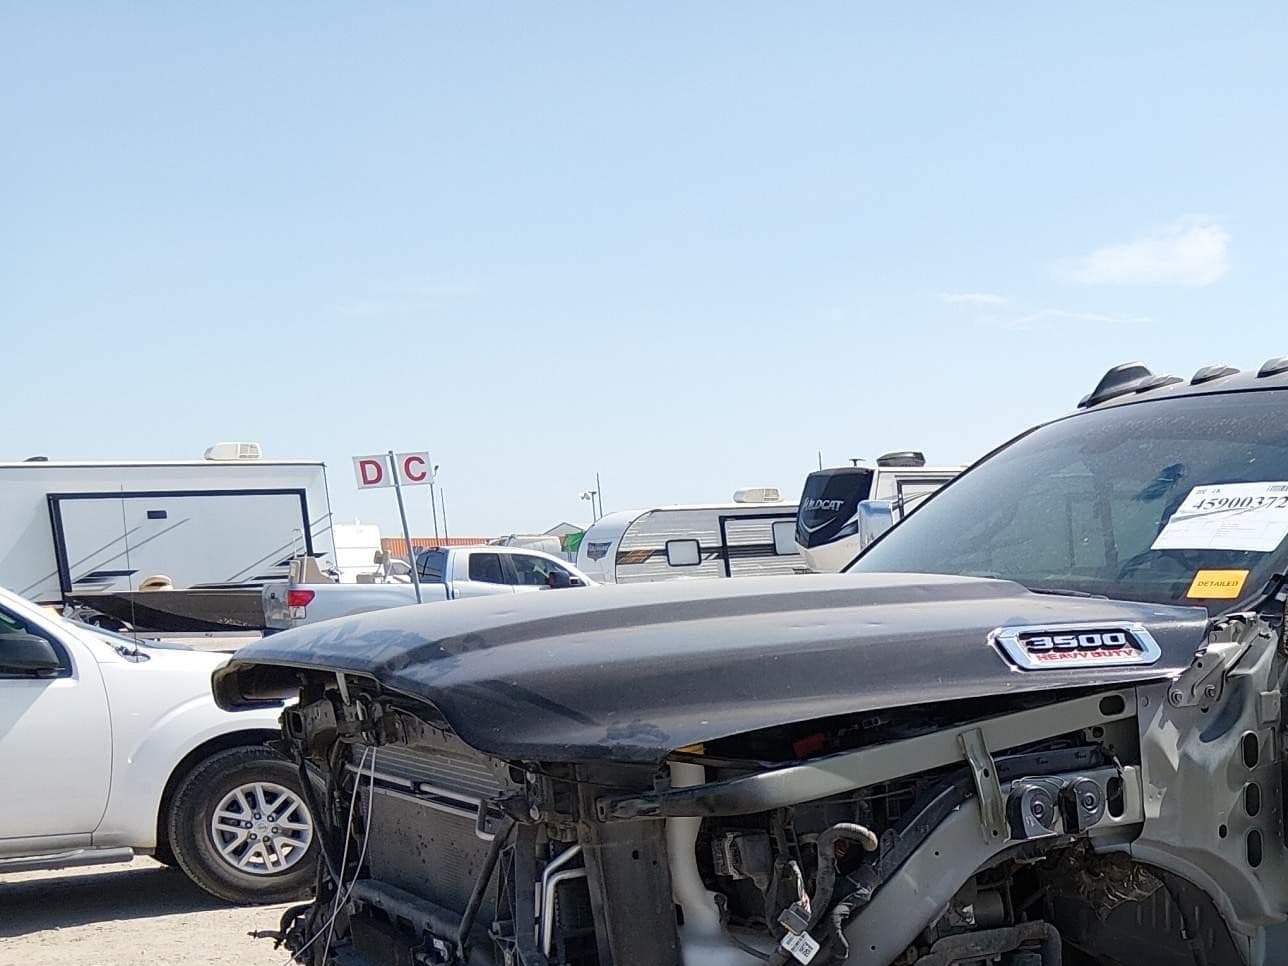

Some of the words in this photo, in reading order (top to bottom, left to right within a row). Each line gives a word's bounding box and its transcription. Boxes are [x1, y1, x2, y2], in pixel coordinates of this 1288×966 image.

[359, 460, 383, 485] D
[404, 456, 427, 482] C
[1027, 632, 1127, 650] 3500
[1036, 652, 1088, 662] HEAVY
[1091, 649, 1134, 660] DUTY
